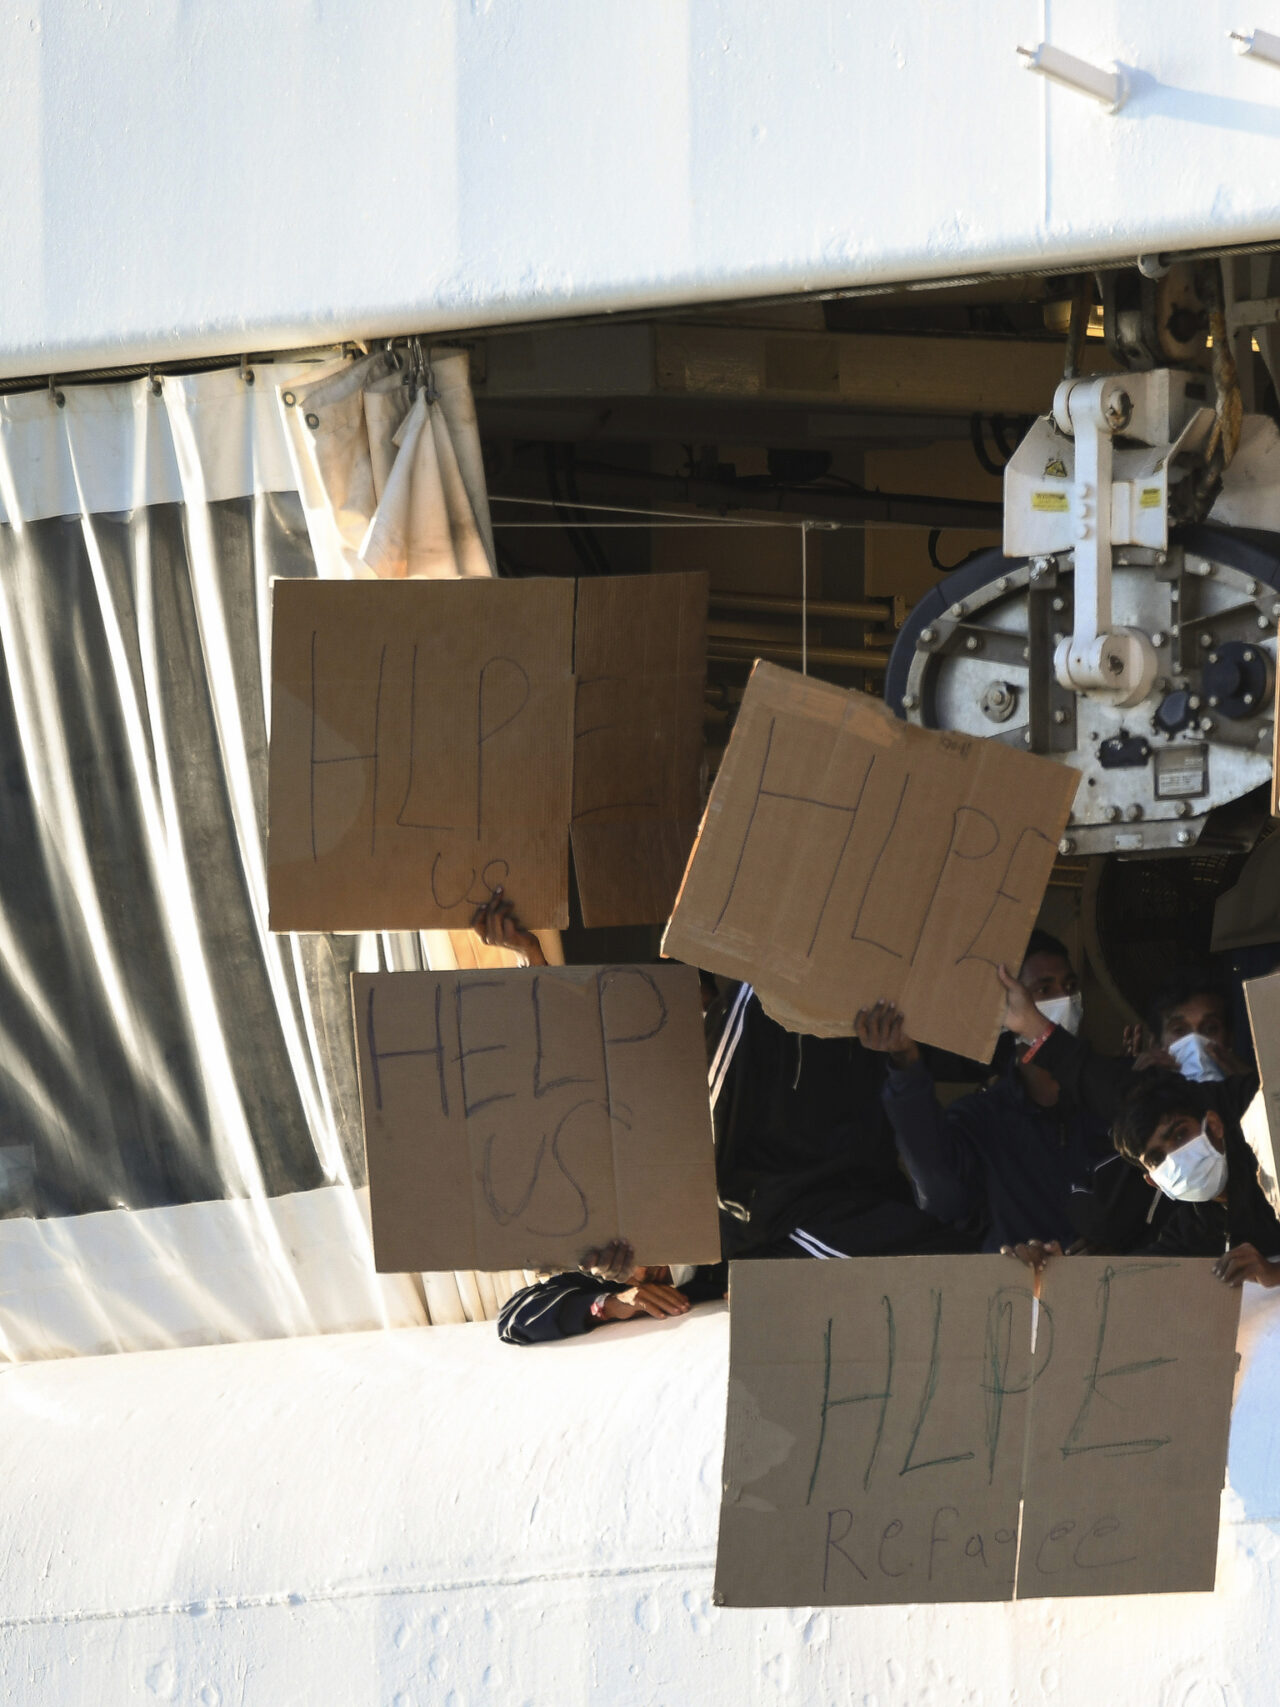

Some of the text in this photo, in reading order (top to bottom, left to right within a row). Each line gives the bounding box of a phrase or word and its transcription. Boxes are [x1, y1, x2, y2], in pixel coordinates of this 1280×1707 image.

[367, 967, 669, 1118] HELP
[483, 1099, 633, 1238] US
[806, 1263, 1181, 1505] HLPE
